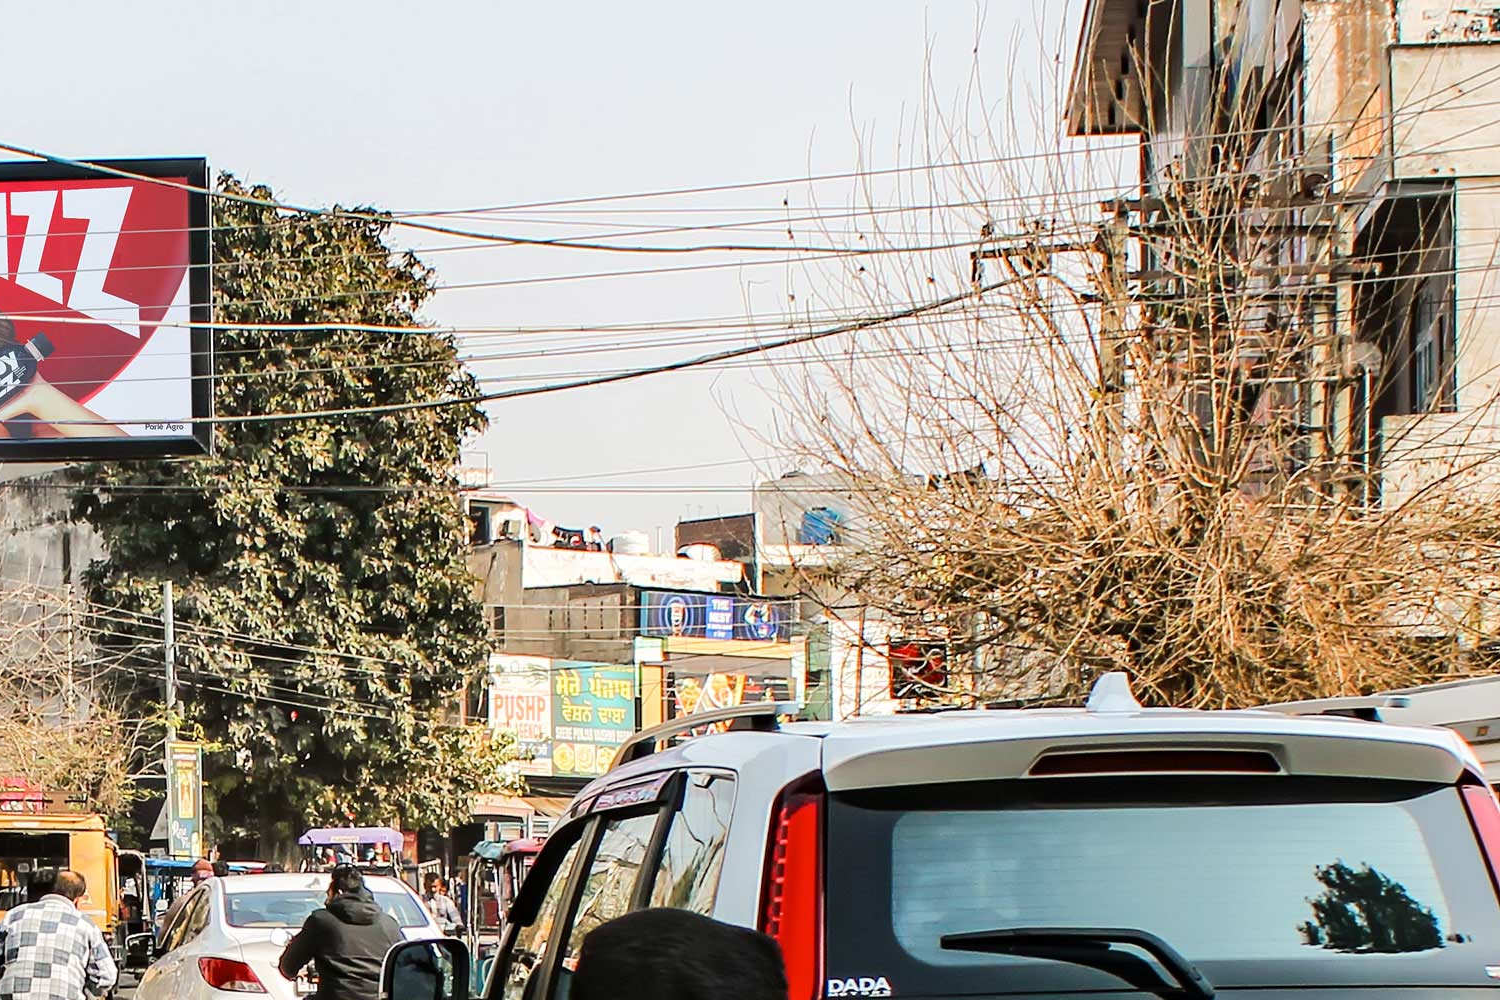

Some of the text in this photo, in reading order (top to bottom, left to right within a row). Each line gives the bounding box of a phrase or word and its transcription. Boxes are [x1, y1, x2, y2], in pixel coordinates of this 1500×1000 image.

[144, 423, 184, 432] Parle Agro
[494, 694, 546, 722] PUSHP
[827, 976, 892, 992] DADA
